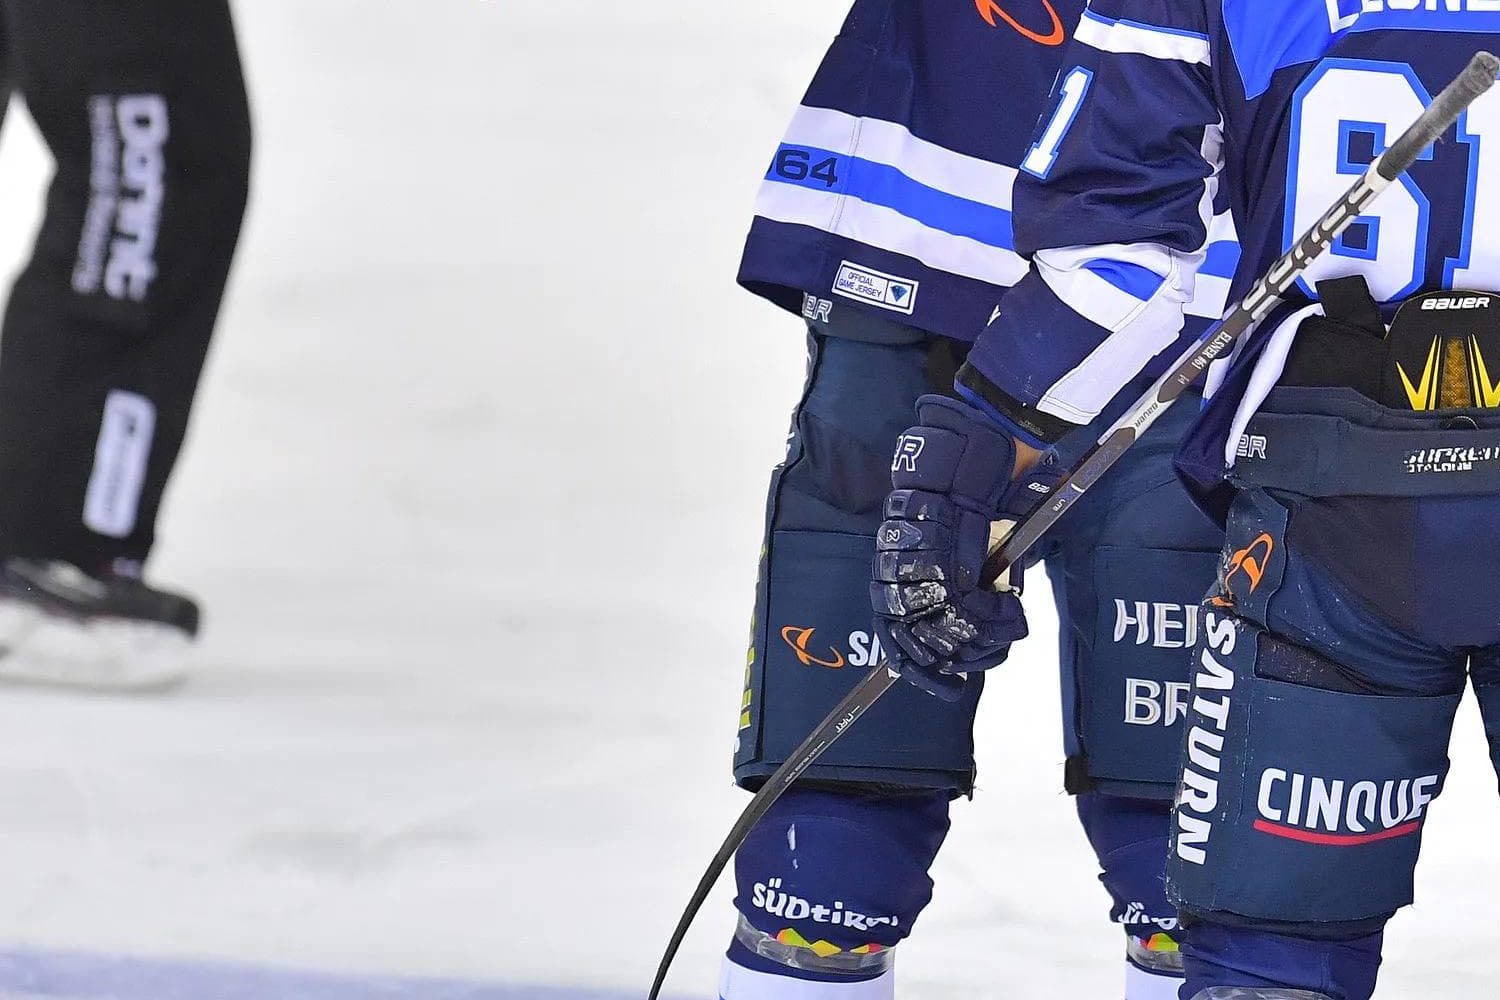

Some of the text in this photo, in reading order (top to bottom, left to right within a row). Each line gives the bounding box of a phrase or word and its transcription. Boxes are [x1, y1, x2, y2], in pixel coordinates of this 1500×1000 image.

[767, 149, 838, 188] 64
[838, 278, 882, 298] GAME JERSEY
[847, 271, 875, 287] OFFICIAL
[1420, 295, 1491, 311] BAUER
[1201, 330, 1233, 360] ELSNER
[1175, 612, 1237, 866] SATURN
[1257, 767, 1439, 833] CINQUE
